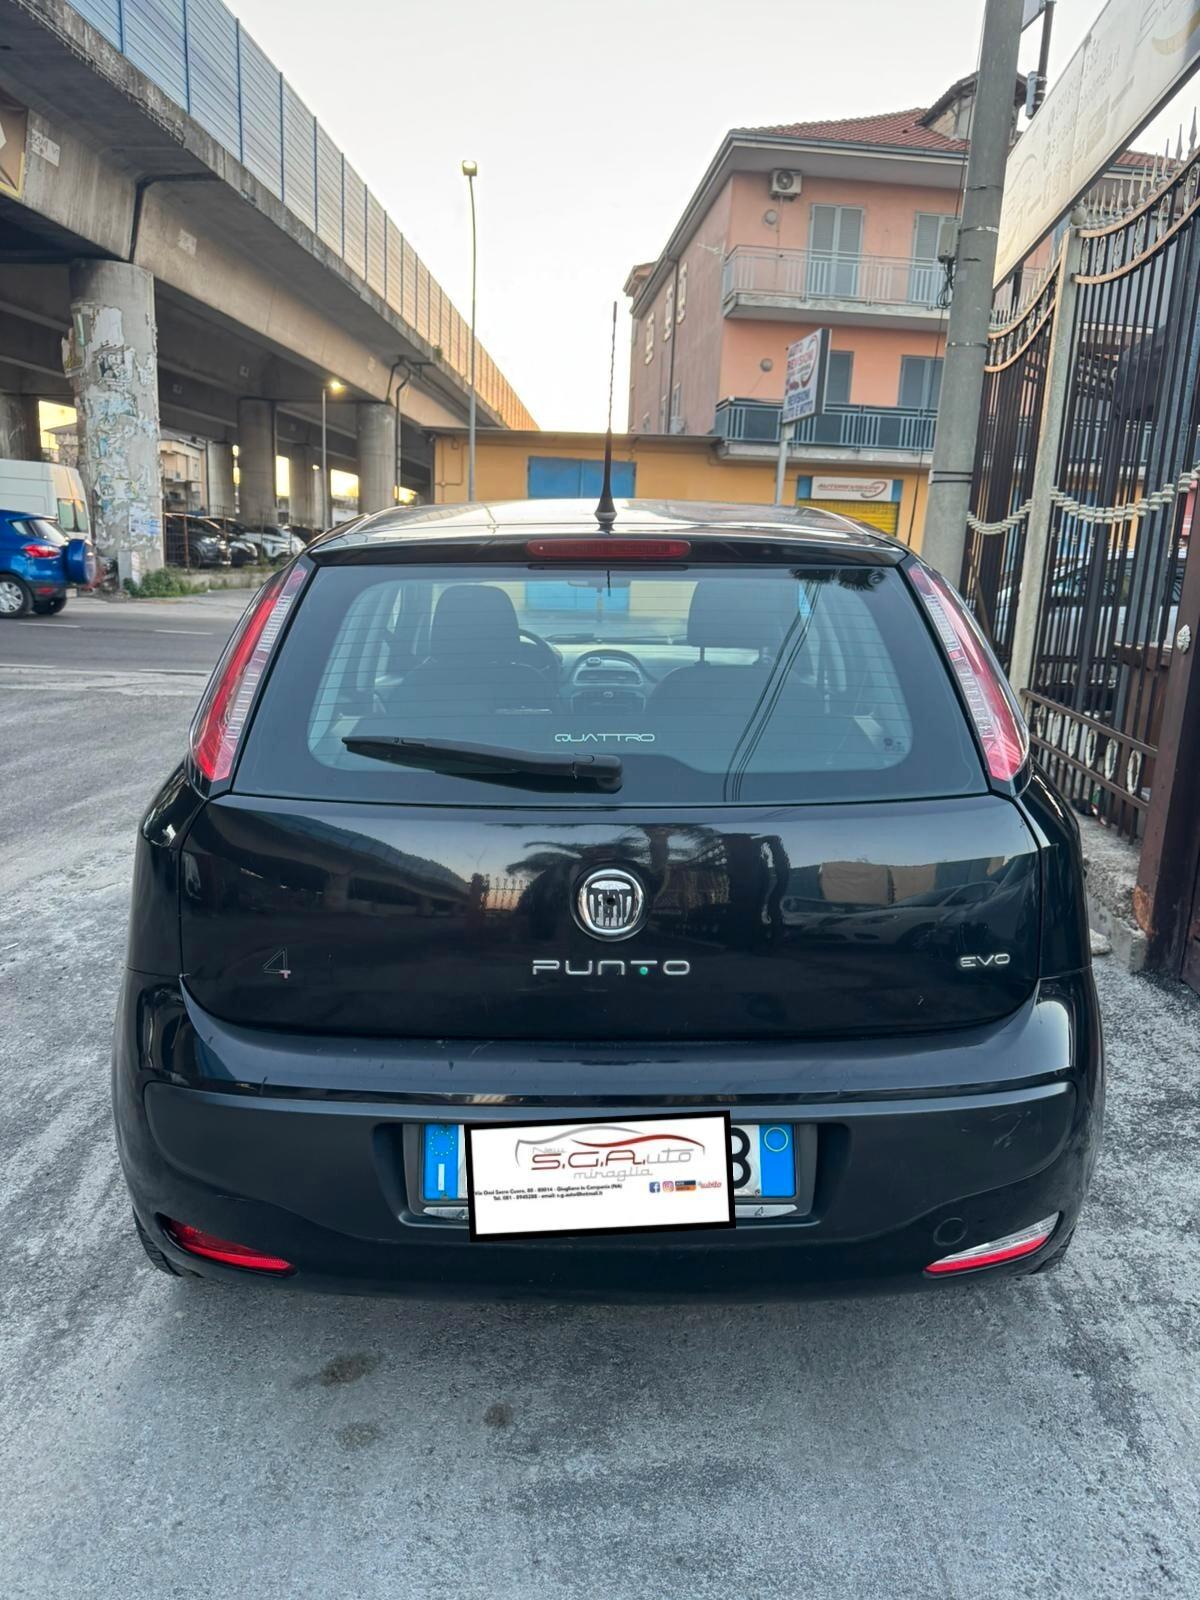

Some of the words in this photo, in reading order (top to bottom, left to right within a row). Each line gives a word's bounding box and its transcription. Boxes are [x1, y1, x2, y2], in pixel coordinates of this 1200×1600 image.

[554, 733, 655, 742] QUATTRO
[960, 953, 1010, 967] EVO
[532, 960, 690, 975] PUNTO
